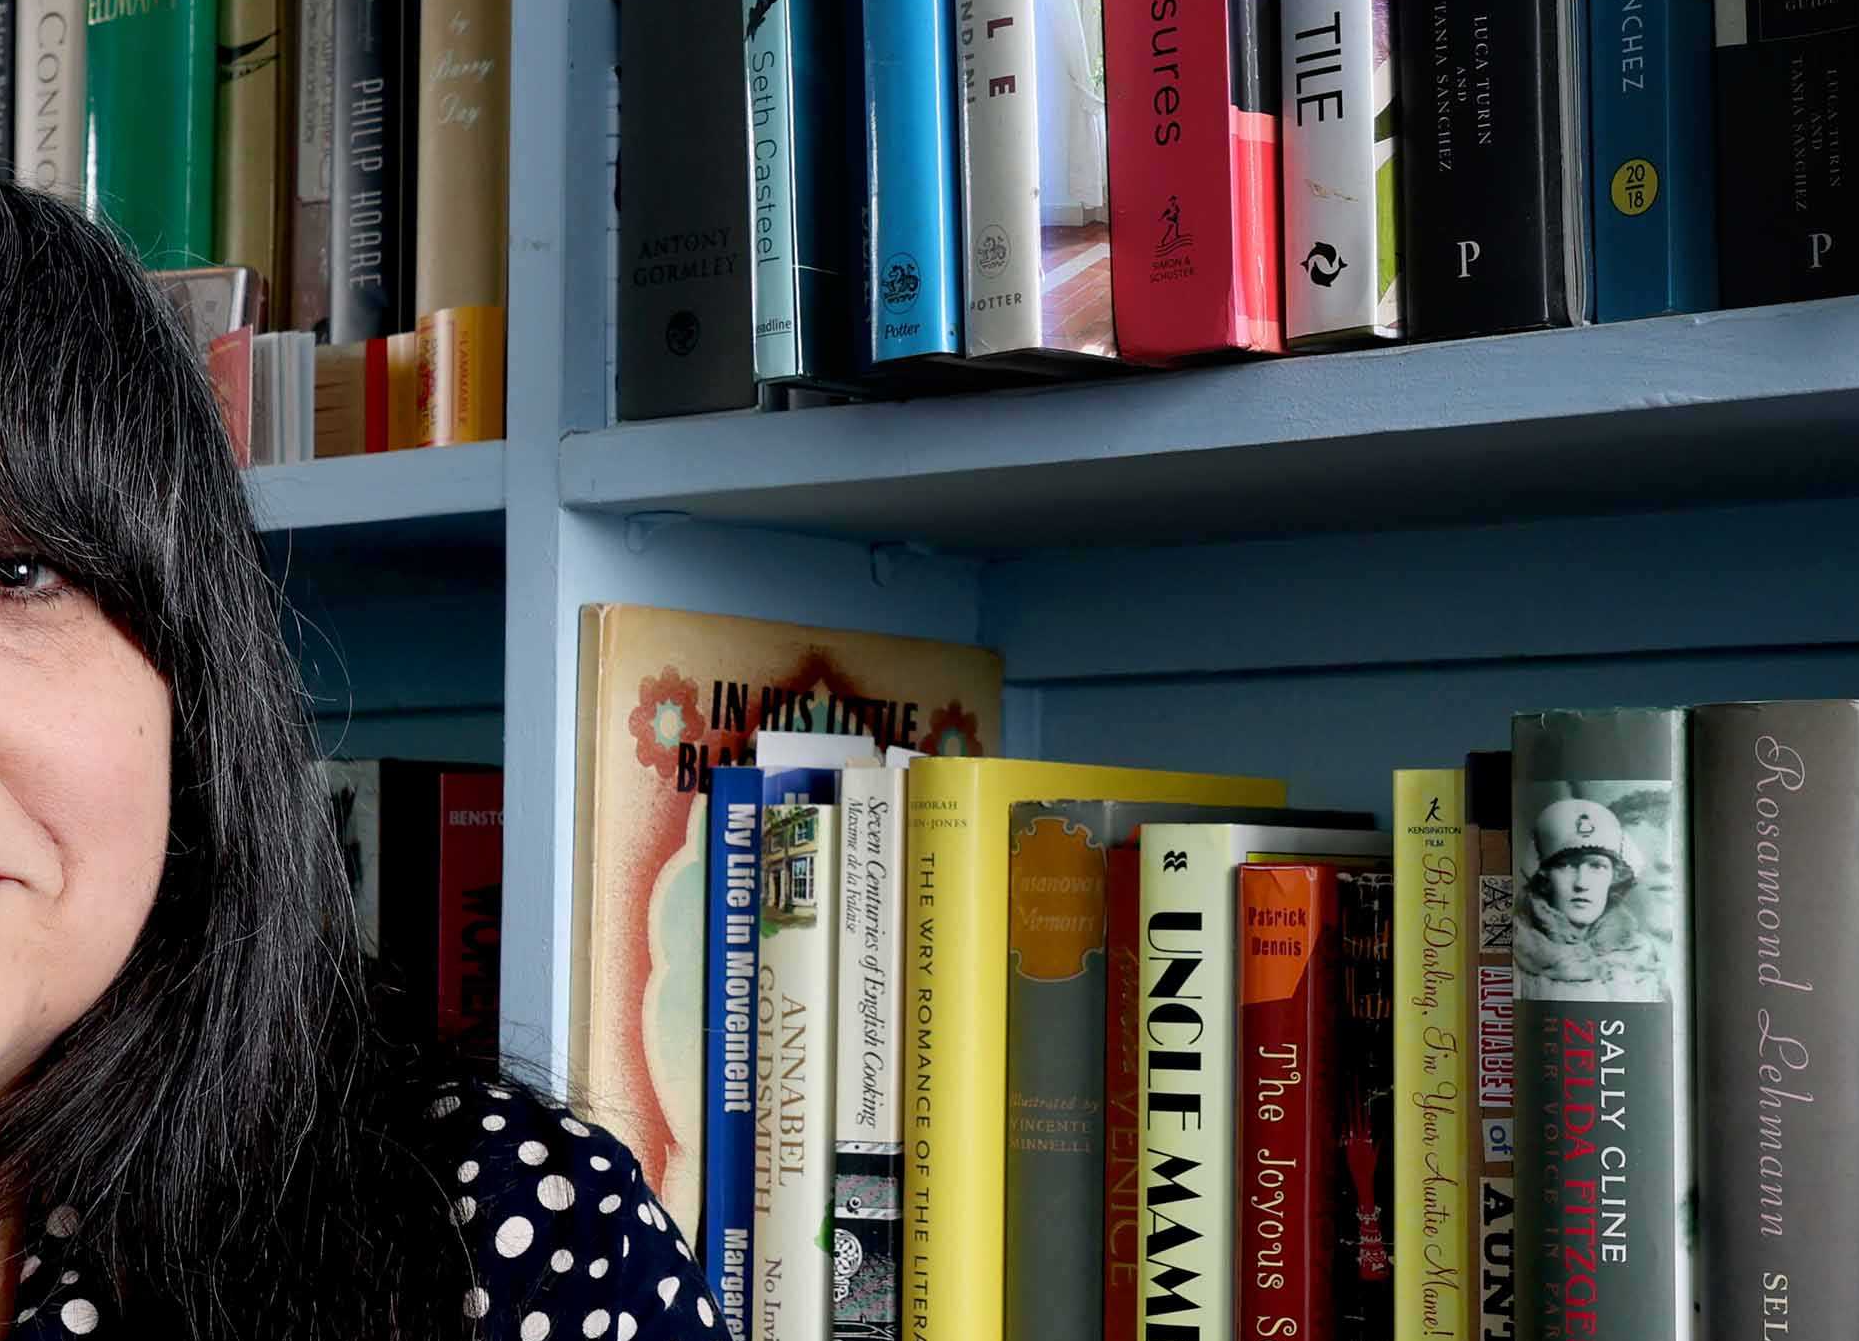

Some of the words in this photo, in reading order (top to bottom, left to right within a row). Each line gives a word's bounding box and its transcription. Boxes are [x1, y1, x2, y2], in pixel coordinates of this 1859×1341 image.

[1295, 10, 1344, 127] TILE
[1625, 165, 1645, 182] 20
[1627, 191, 1645, 209] 18
[723, 803, 756, 847] My
[1753, 734, 1814, 993] Rosamond
[724, 853, 756, 909] Life
[918, 852, 935, 908] THE
[724, 916, 755, 945] in
[918, 916, 936, 983] WRY
[722, 944, 759, 1113] Movement
[912, 989, 933, 1130] ROMANCE
[1146, 911, 1204, 1132] UNCLE
[1258, 1044, 1301, 1123] The
[1562, 1018, 1596, 1160] ZELDA
[1599, 1018, 1627, 1131] SALLY
[914, 1139, 931, 1177] OF
[1757, 1008, 1815, 1238] Lehmann
[913, 1193, 930, 1242] THE
[1250, 1149, 1297, 1290] Joyous
[1600, 1145, 1628, 1264] CLINE
